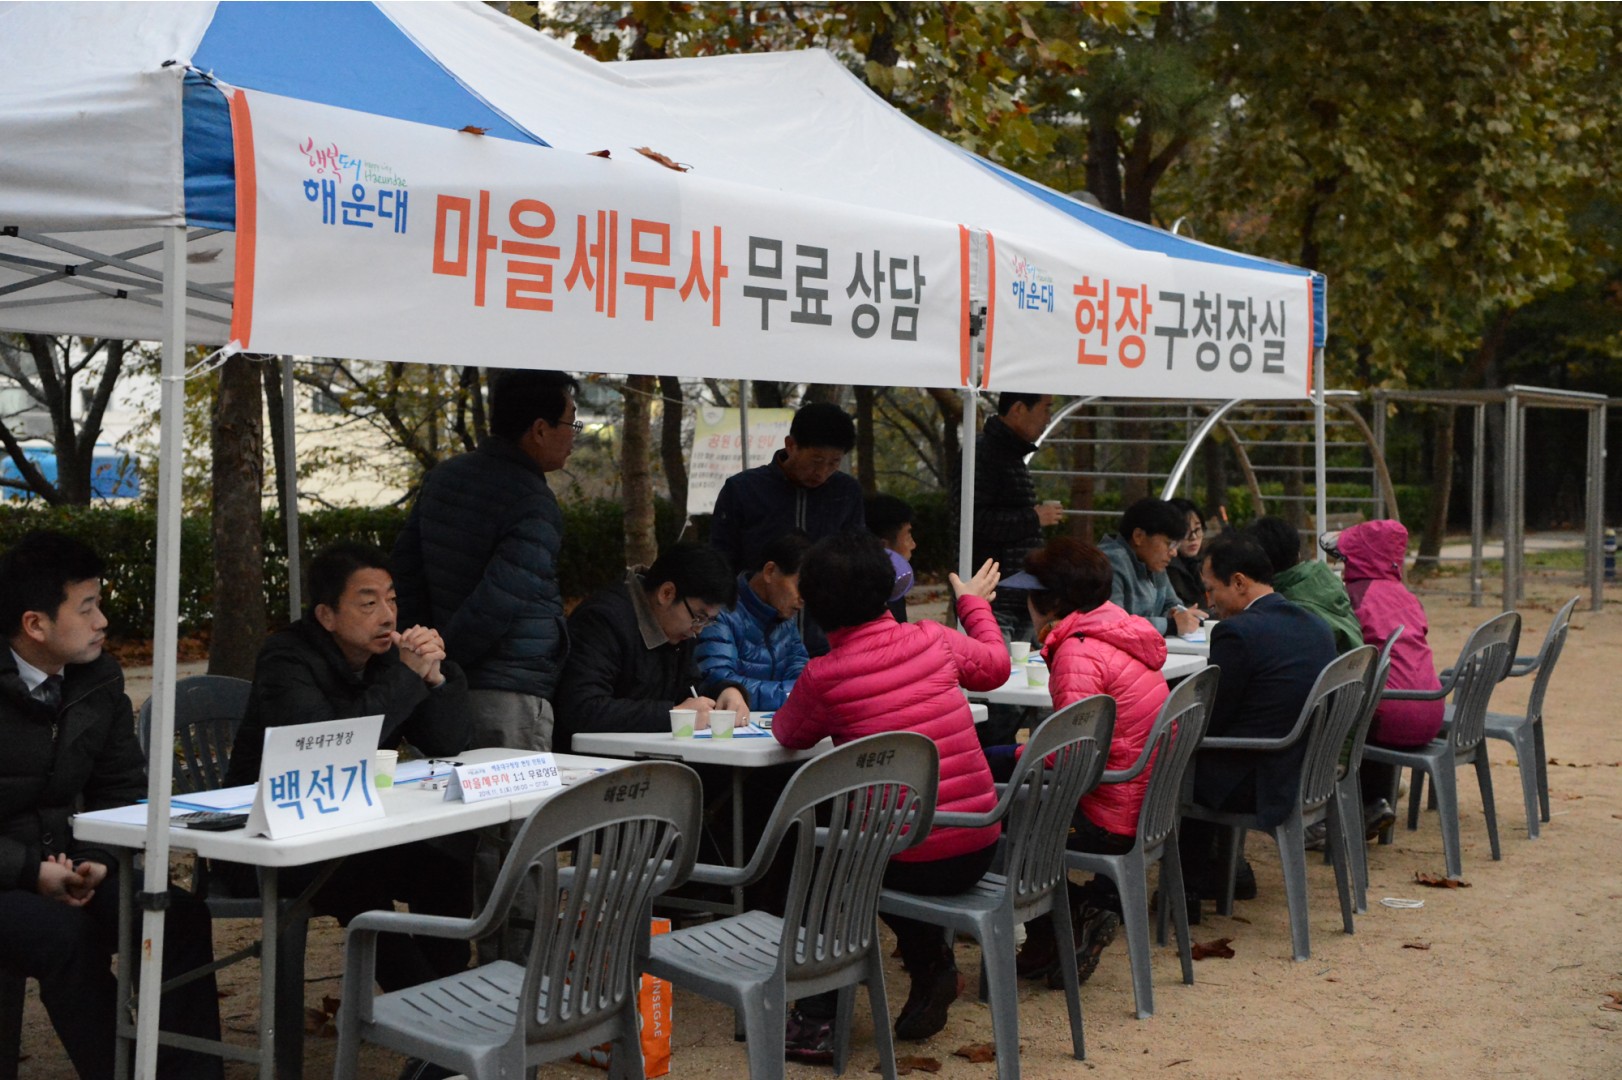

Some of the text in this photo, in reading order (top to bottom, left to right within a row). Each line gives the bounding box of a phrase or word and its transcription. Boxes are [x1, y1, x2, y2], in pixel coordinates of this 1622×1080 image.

[303, 179, 408, 234] 해운대
[432, 189, 926, 341] 마을세무사 무료 상담
[1012, 280, 1054, 312] 해운대
[1073, 276, 1285, 373] 현장구청장실
[295, 730, 355, 751] 해운대구청장
[855, 749, 896, 768] 해운대구
[269, 759, 373, 821] 백선기
[462, 766, 558, 790] 마을세무사 1:1 무료상담
[604, 778, 651, 802] 해운대구
[652, 975, 663, 1038] INSEGAE
